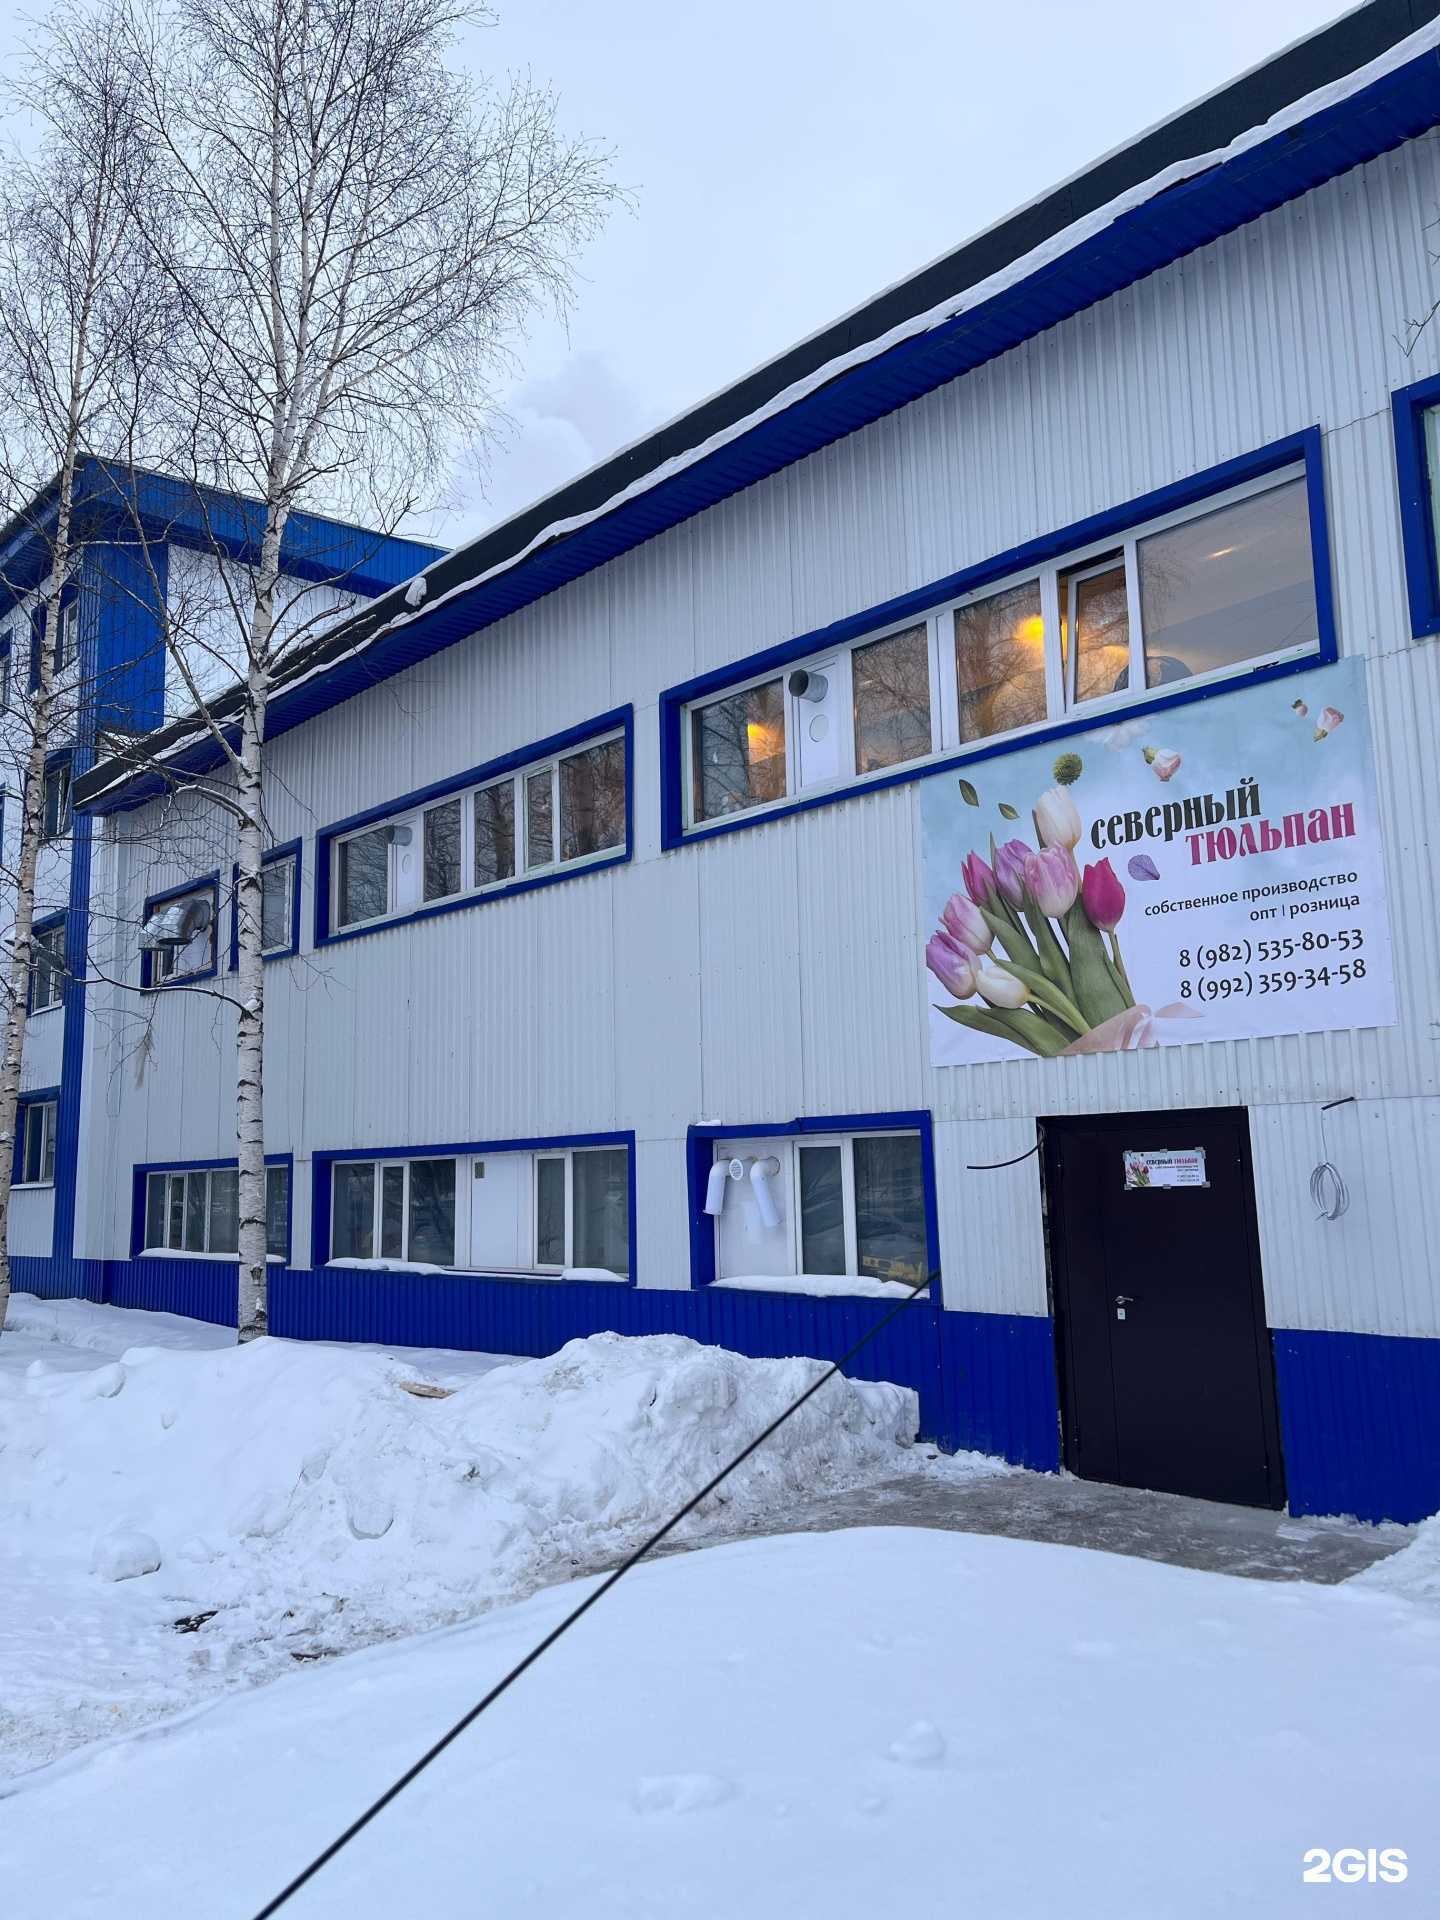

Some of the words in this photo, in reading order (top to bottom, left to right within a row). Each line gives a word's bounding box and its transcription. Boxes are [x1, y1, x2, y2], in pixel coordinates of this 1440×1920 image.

[1090, 776, 1262, 850] северный
[1185, 802, 1357, 866] тюльпан
[1144, 890, 1239, 917] собственное
[1242, 871, 1358, 903] производство
[1249, 906, 1278, 921] опт
[1289, 894, 1361, 920] розница
[1179, 949, 1191, 968] 8
[1196, 939, 1252, 970] (982)
[1257, 928, 1364, 962] 535-80-53
[1180, 979, 1192, 999] 8
[1198, 971, 1253, 1001] (992)
[1258, 958, 1367, 995] 359-34-58
